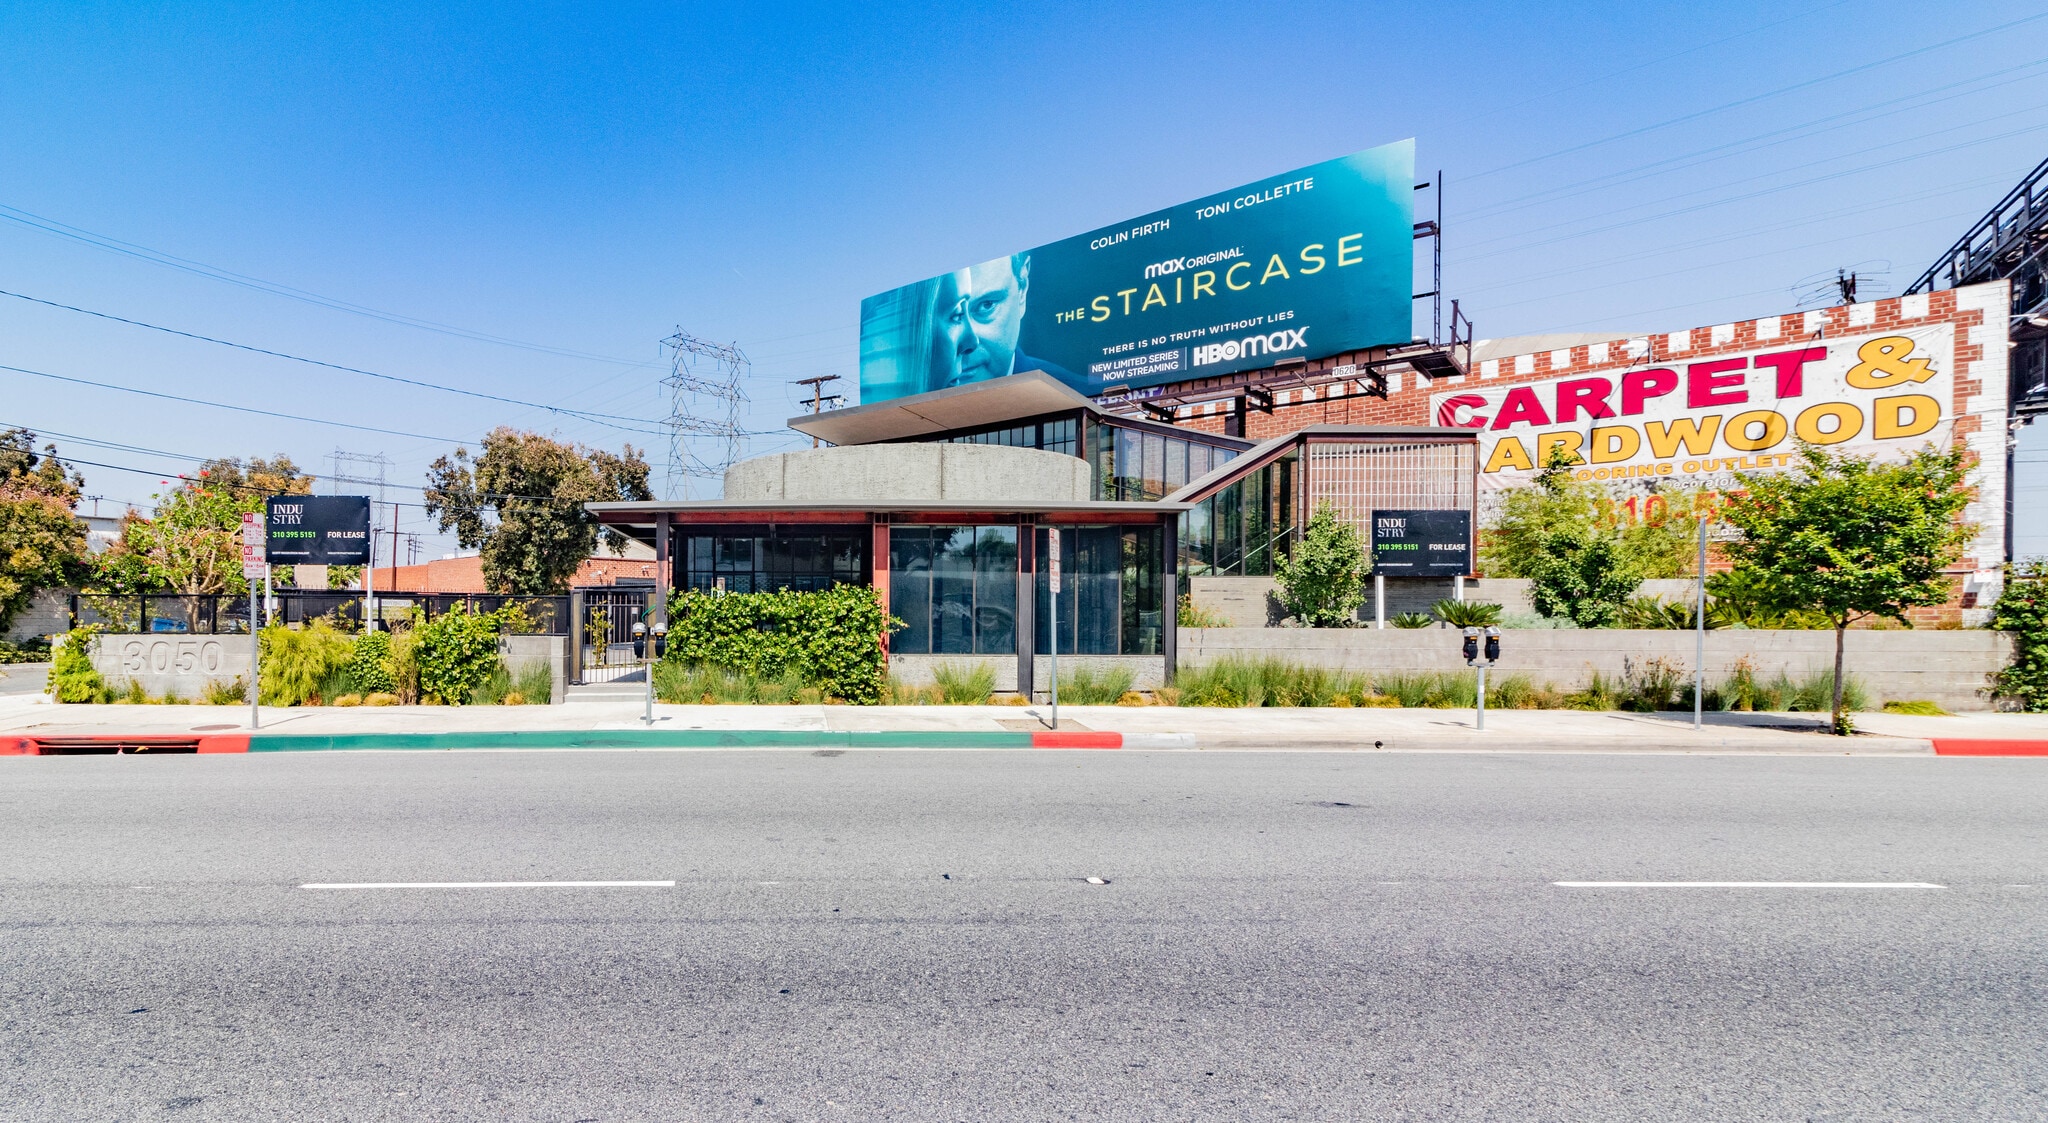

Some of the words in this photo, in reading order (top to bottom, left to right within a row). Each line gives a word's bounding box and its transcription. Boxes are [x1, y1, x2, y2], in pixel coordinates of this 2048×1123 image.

[1195, 202, 1230, 220] TONI
[1233, 177, 1314, 210] COLLETTE
[1090, 231, 1128, 250] COLIN
[1132, 218, 1170, 239] FIRTH
[1145, 256, 1185, 279] max
[1186, 248, 1244, 269] ORIGINAL
[1056, 308, 1085, 324] THE
[1091, 232, 1364, 322] STAIRCASE
[1103, 342, 1135, 355] THERE
[1138, 339, 1148, 348] IS
[1151, 336, 1166, 346] NO
[1170, 328, 1205, 341] TRUTH
[1209, 316, 1263, 335] WITHOUT
[1267, 310, 1294, 323] LIES
[1091, 361, 1113, 373] NEW
[1113, 355, 1147, 369] LIMITED
[1149, 350, 1179, 363] SERIES
[1103, 370, 1127, 381] NOW
[1127, 361, 1179, 378] STREAMING
[1333, 365, 1355, 376] 0620
[1438, 346, 1827, 430] CARPET
[1846, 336, 1938, 389] &
[1477, 394, 1941, 473] ARDWOOD
[1682, 452, 1792, 473] OUTLET
[244, 514, 253, 522] NO
[272, 514, 303, 525] STRY
[273, 504, 304, 514] INDU
[1377, 518, 1406, 528] INDU
[1377, 528, 1406, 537] STRY
[244, 547, 252, 555] NO
[1443, 543, 1466, 551] LEASE
[123, 640, 224, 675] 3050
